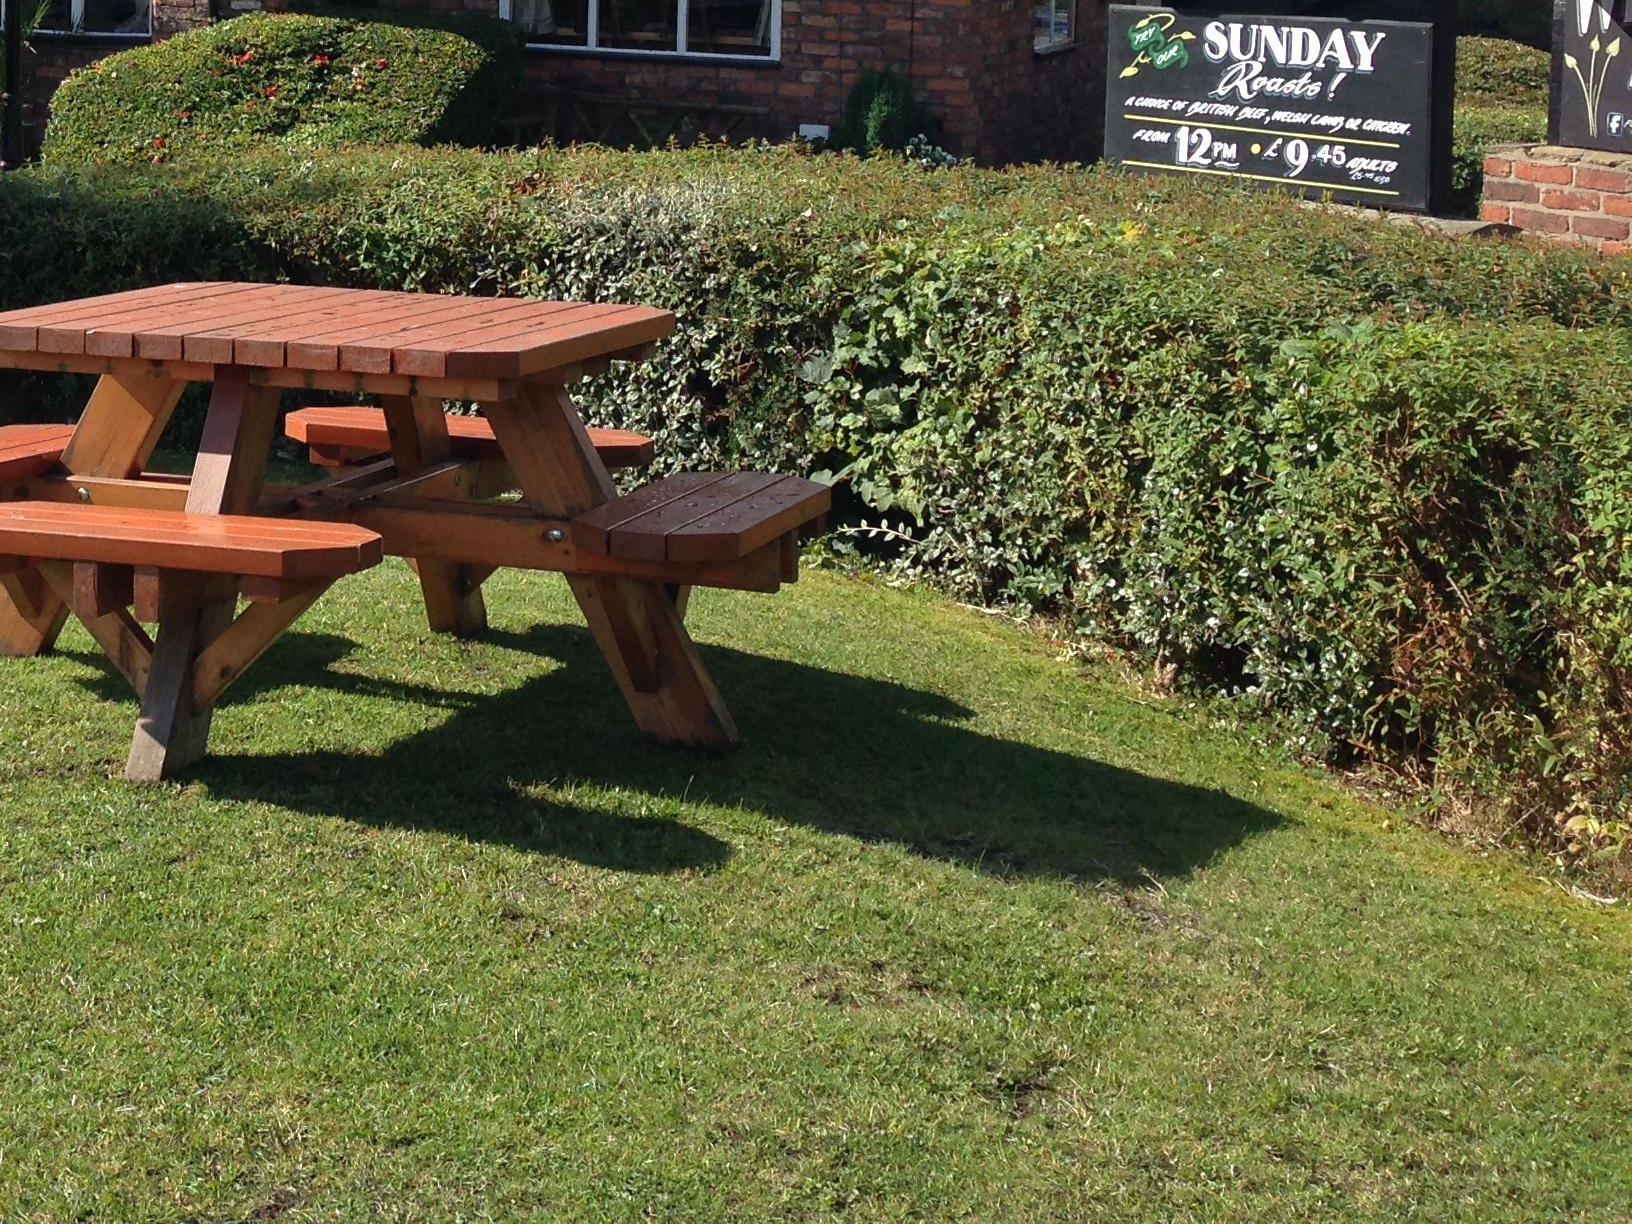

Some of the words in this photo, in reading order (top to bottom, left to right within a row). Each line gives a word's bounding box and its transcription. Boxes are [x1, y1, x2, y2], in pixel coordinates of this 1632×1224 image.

[1135, 26, 1156, 45] TRY
[1203, 21, 1386, 73] SUNDAY
[1157, 45, 1178, 65] OUR
[1125, 96, 1136, 106] A
[1135, 97, 1172, 110] CHOICE
[1172, 101, 1189, 111] OF
[1185, 102, 1239, 116] BRITISH
[1272, 110, 1312, 124] WELSH
[1345, 118, 1362, 130] OR
[1133, 129, 1171, 144] FROM
[1345, 157, 1398, 174] ADULTS
